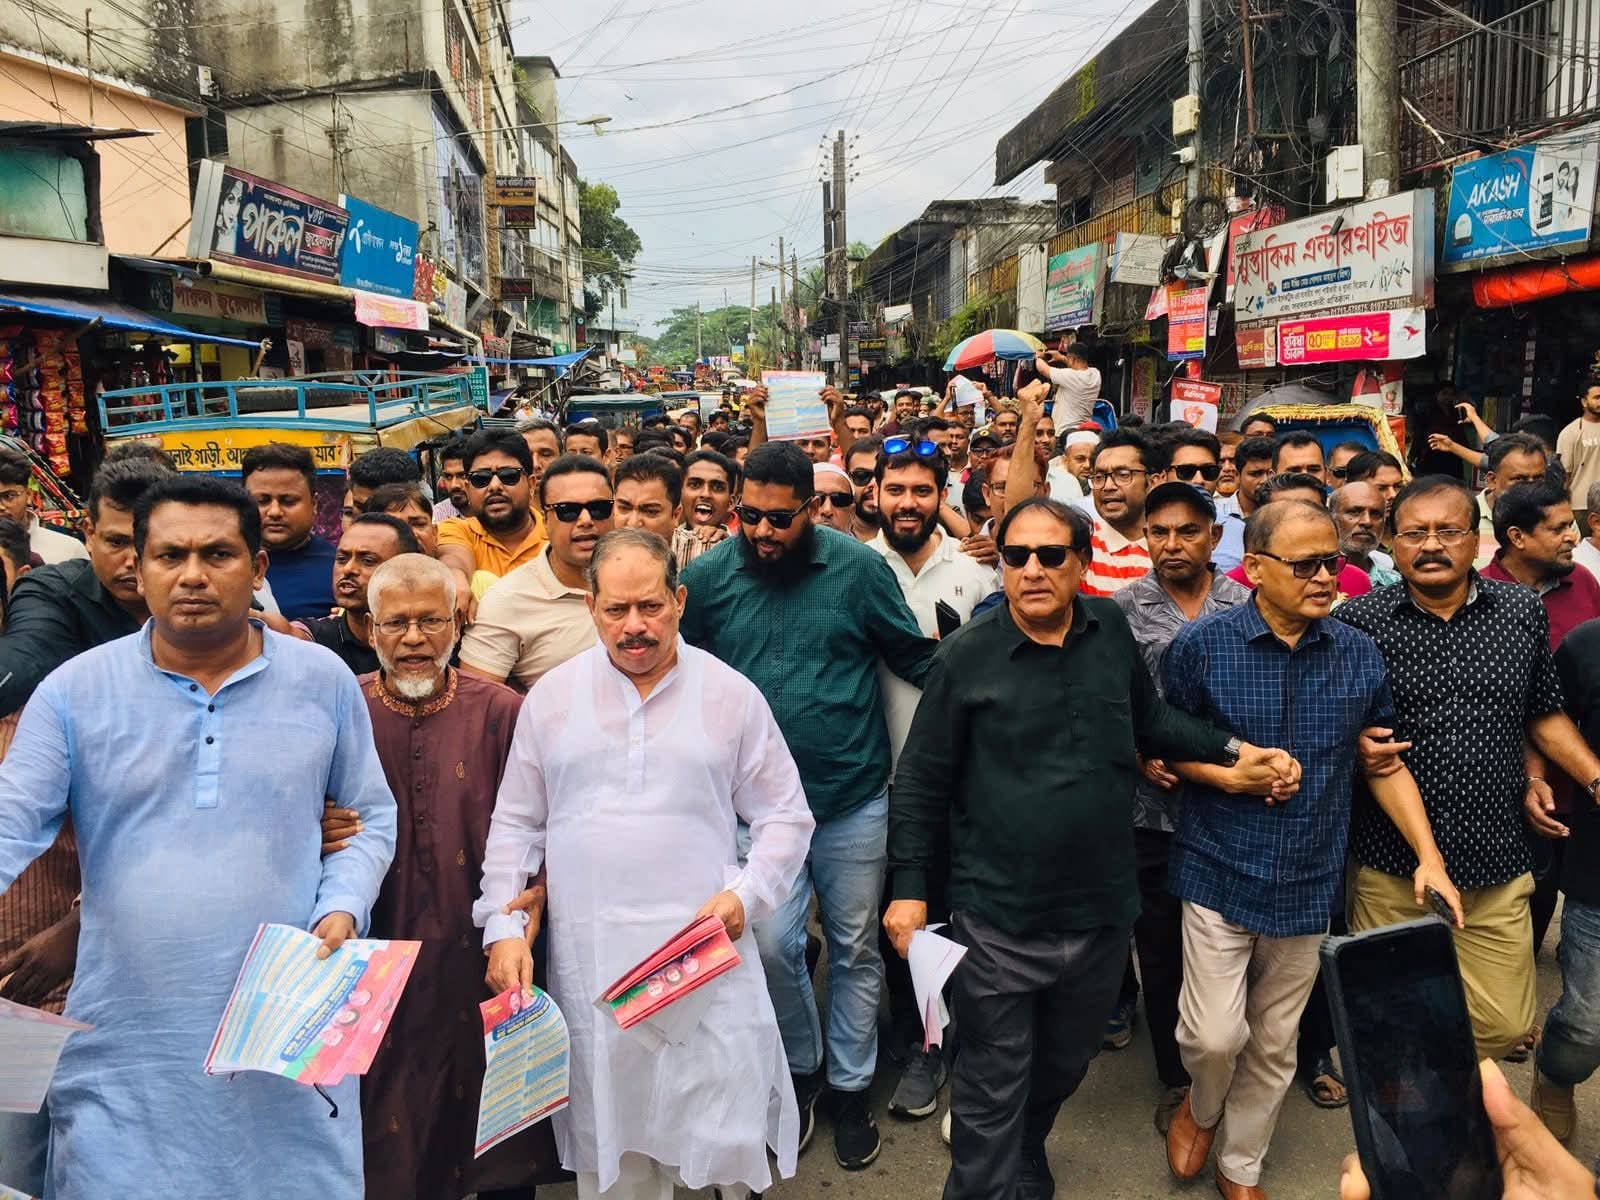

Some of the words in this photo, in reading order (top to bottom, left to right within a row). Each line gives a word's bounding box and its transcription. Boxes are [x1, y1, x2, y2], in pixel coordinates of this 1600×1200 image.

[1466, 172, 1521, 209] AKASH
[242, 202, 305, 264] পারুল
[1236, 234, 1297, 286] মুস্তাকিম
[1302, 211, 1411, 267] এন্টারপ্রাইজ
[174, 284, 214, 309] পারুল
